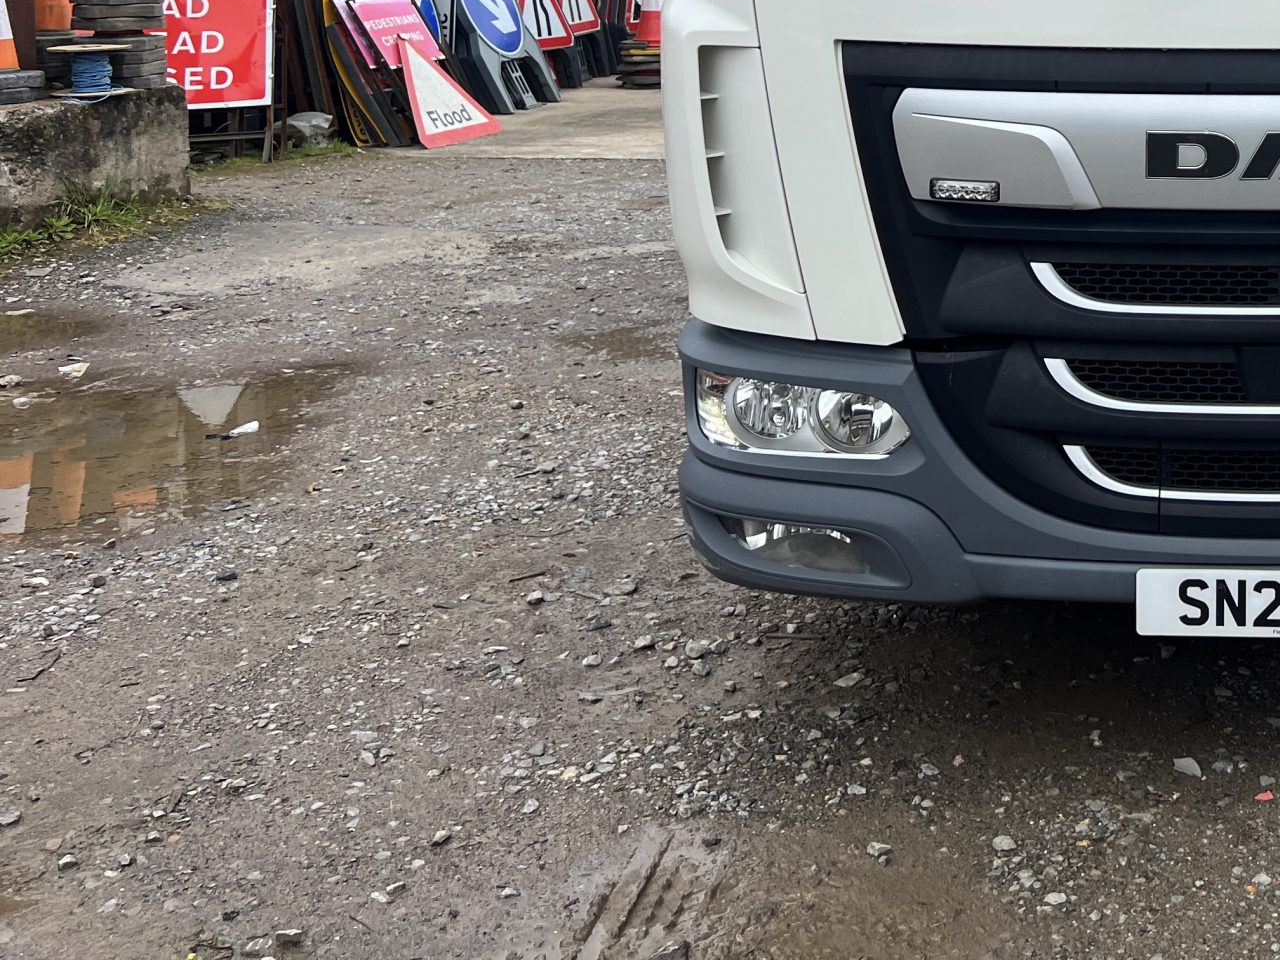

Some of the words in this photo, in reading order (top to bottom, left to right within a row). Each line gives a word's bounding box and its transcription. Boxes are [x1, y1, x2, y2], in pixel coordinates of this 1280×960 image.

[363, 13, 420, 31] PEDESTRIANS
[166, 66, 234, 91] SED
[426, 104, 473, 129] Flood
